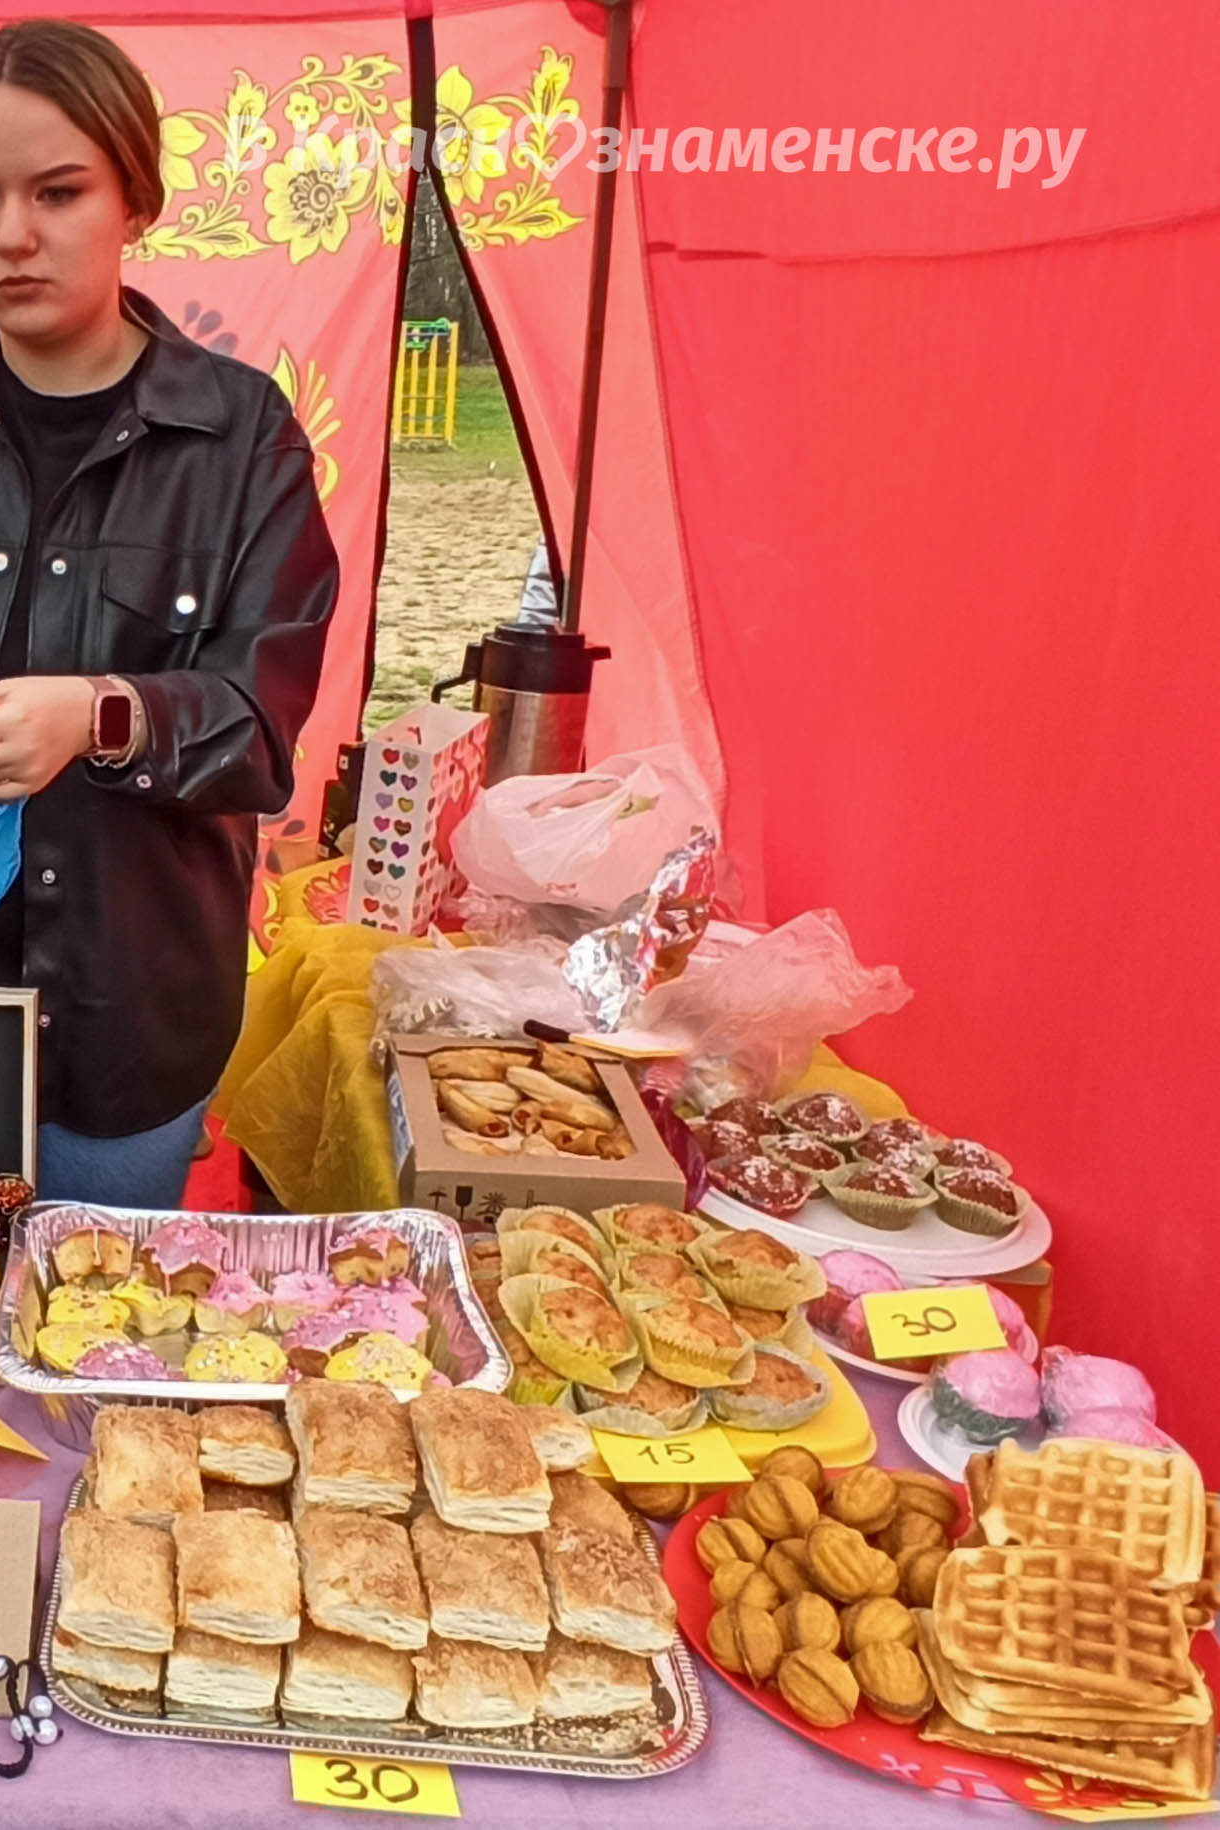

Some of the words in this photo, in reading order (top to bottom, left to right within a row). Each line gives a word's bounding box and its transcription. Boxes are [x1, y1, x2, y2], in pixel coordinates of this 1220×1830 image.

[891, 1306, 957, 1337] 30
[637, 1441, 696, 1466] 15
[324, 1758, 420, 1804] 30
